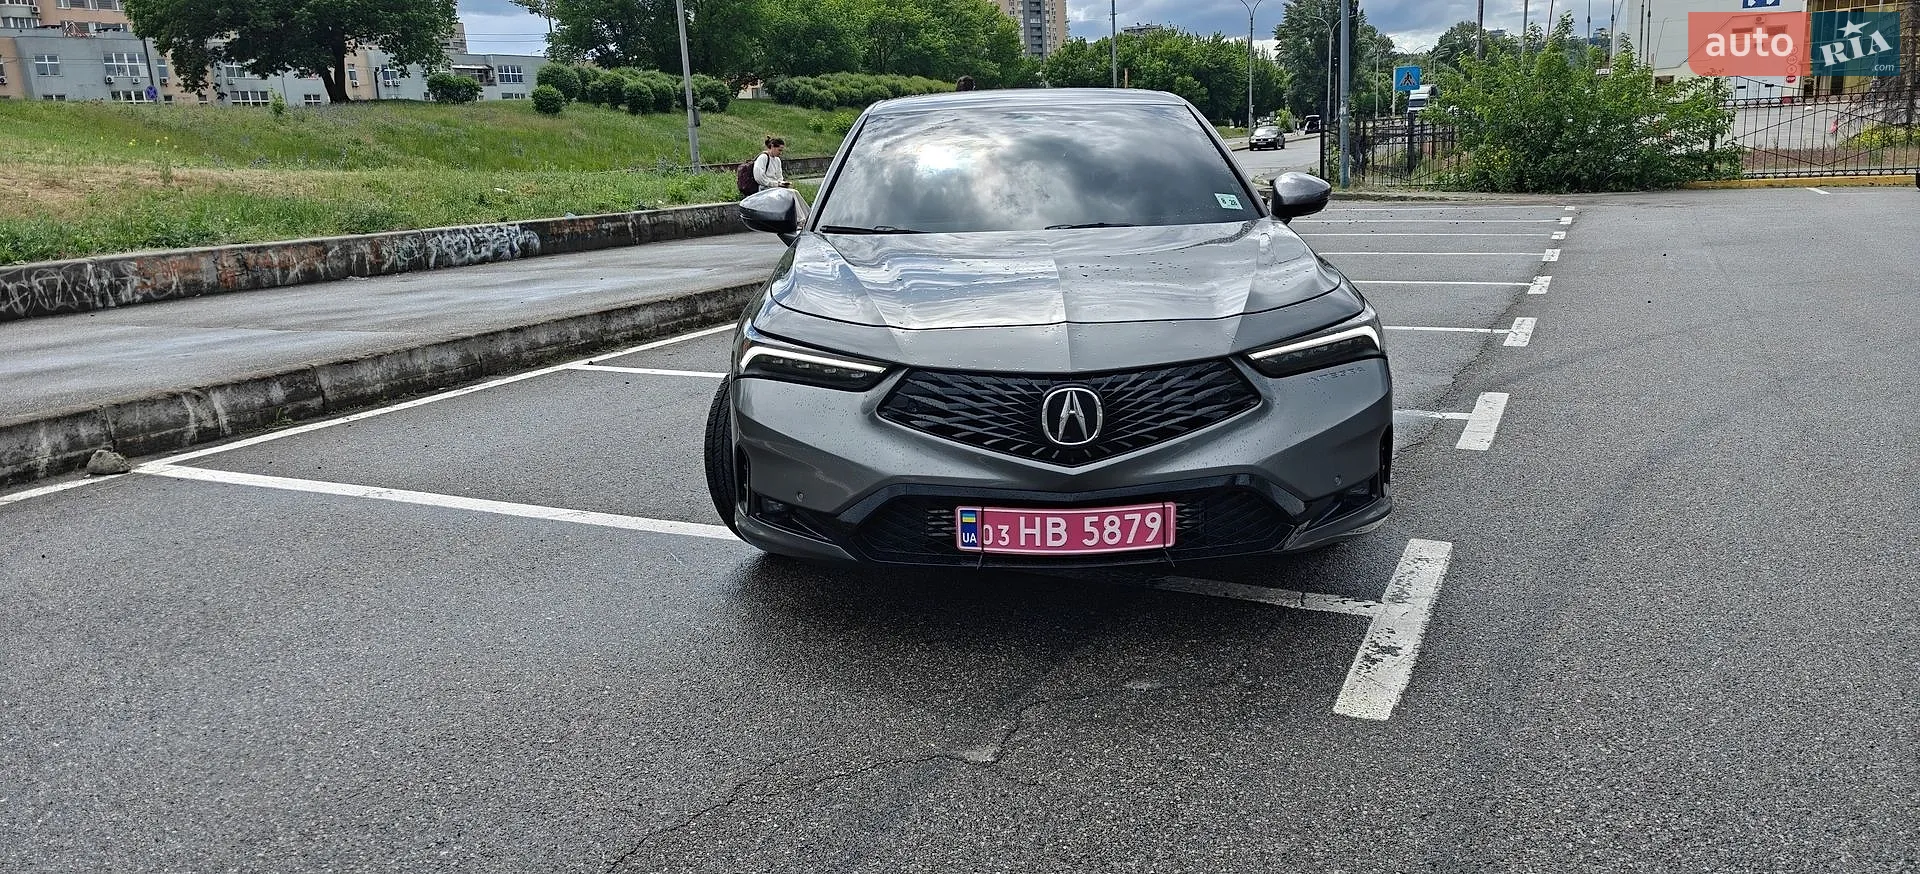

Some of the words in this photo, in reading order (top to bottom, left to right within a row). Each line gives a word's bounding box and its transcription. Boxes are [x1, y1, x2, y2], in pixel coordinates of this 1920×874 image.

[962, 532, 977, 543] UA
[983, 524, 1010, 546] 03
[1019, 516, 1068, 547] HB
[1082, 511, 1163, 547] 5879
